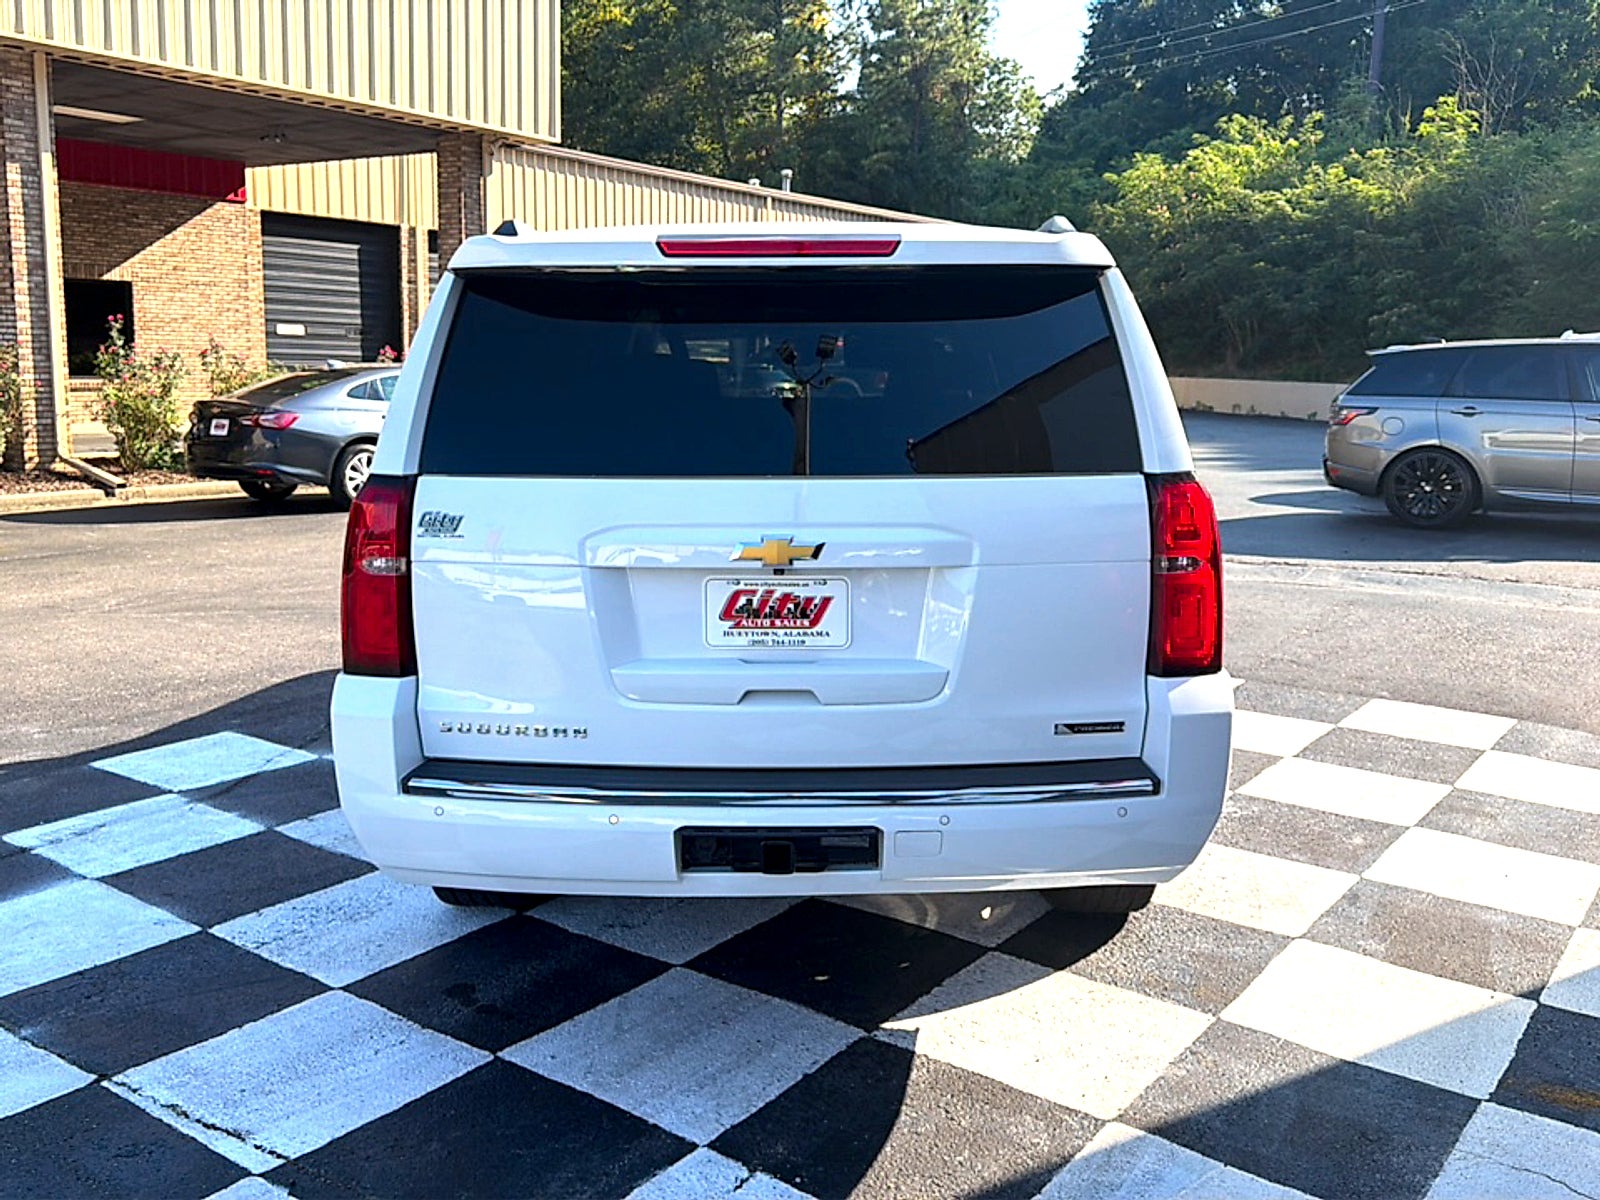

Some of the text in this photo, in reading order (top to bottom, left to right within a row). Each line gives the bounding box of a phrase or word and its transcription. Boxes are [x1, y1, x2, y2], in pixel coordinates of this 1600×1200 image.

[718, 588, 835, 629] City
[739, 619, 811, 628] AUTO SALES
[783, 629, 831, 638] ALABAMA
[439, 721, 589, 740] SUBURBAN
